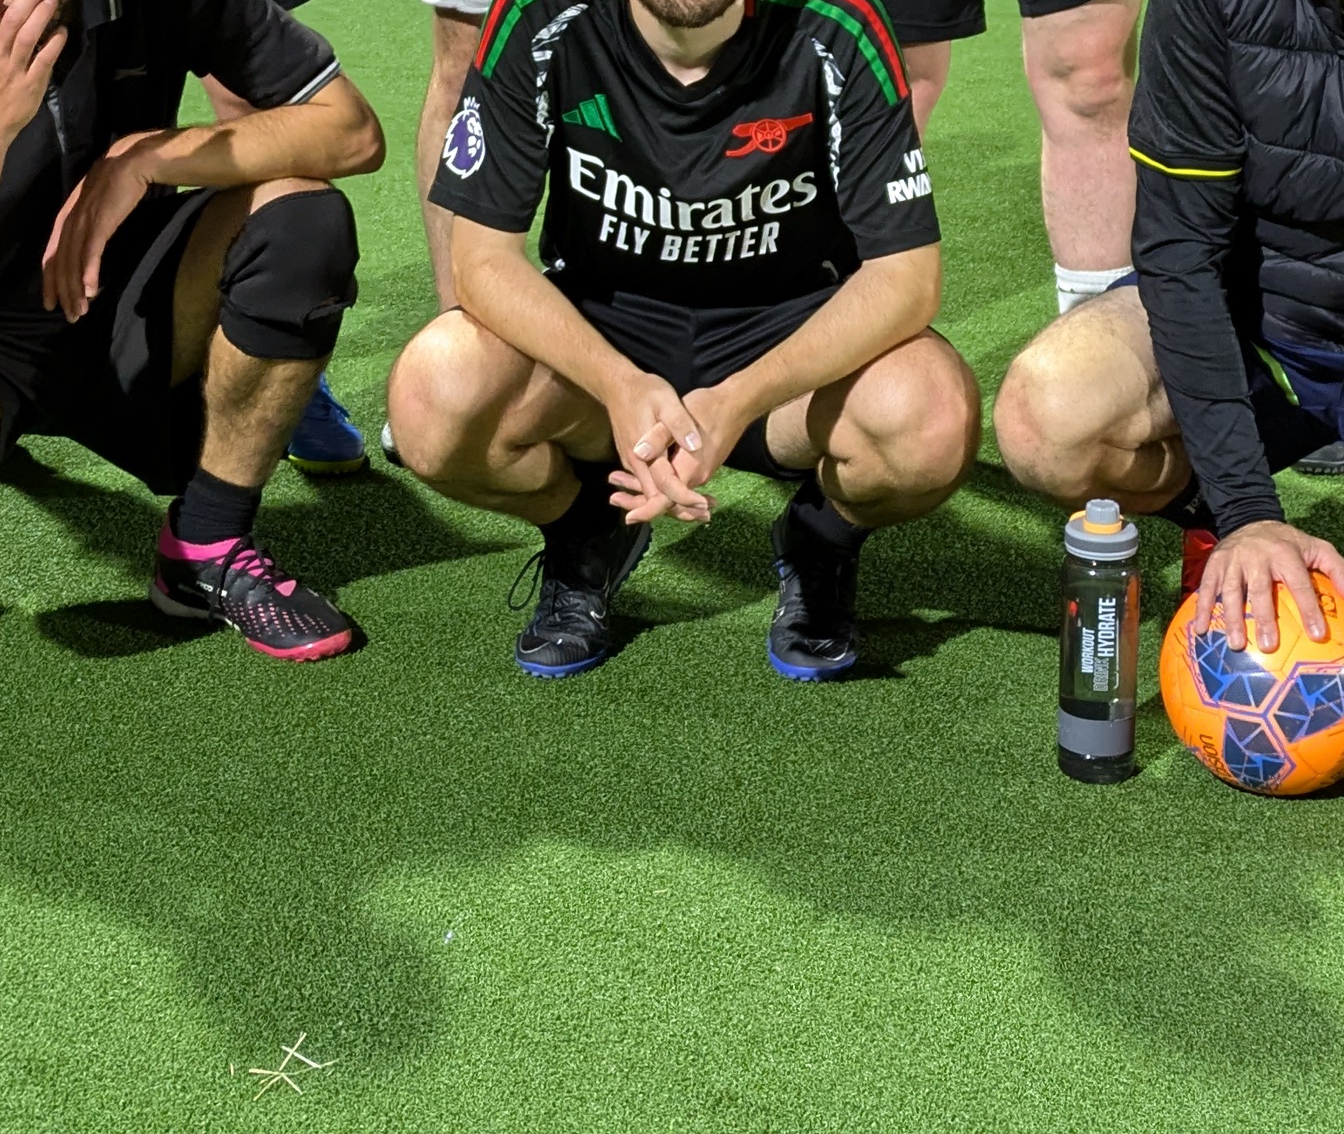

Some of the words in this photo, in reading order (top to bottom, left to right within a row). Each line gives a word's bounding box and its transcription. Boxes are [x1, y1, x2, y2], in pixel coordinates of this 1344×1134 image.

[566, 147, 818, 231] Emirates
[599, 214, 650, 255] FLY
[660, 221, 781, 263] BETTER
[1081, 627, 1095, 673] WORKOUT
[1097, 598, 1116, 657] HYDRATE
